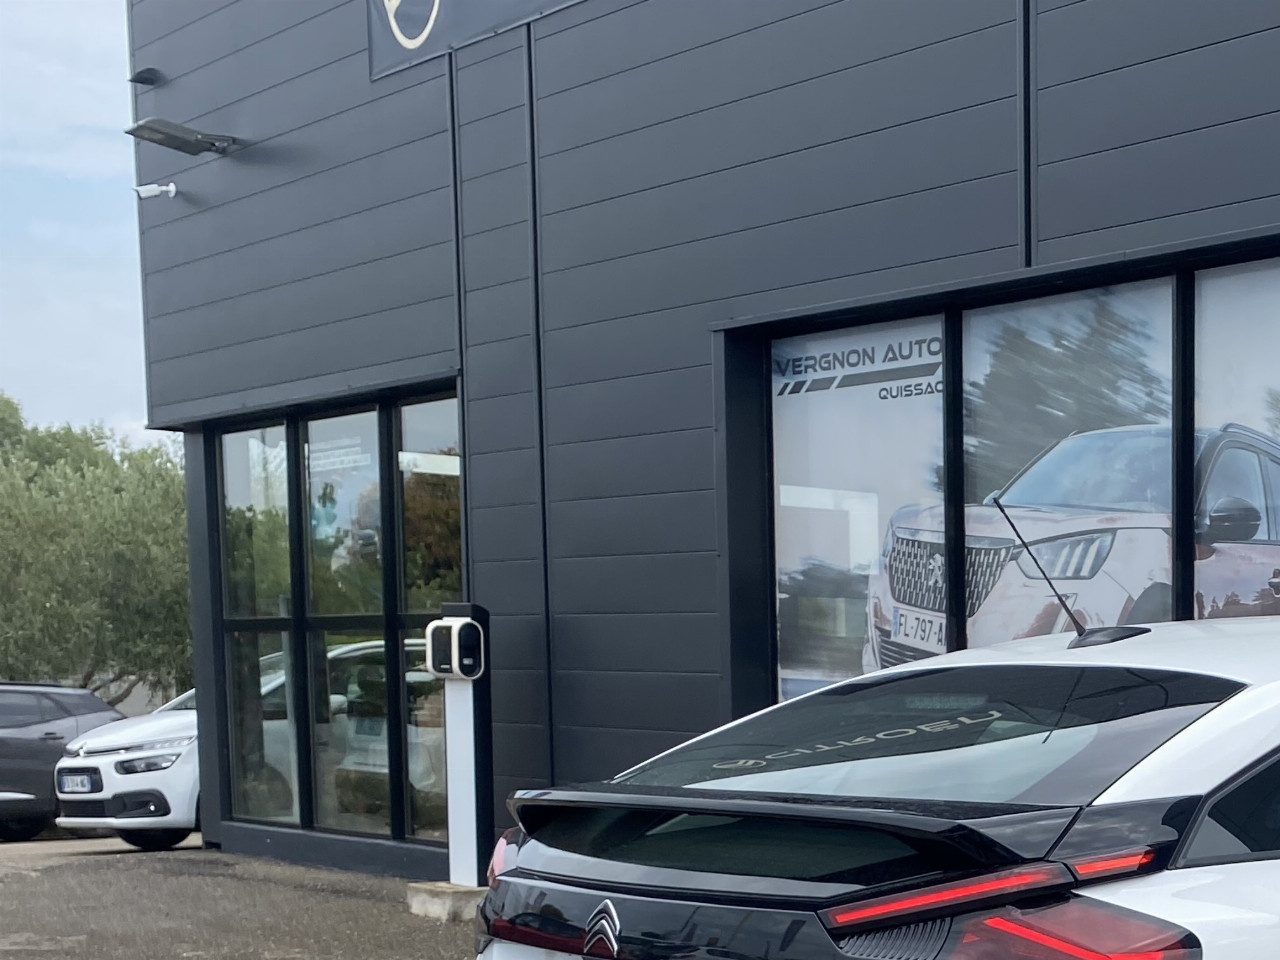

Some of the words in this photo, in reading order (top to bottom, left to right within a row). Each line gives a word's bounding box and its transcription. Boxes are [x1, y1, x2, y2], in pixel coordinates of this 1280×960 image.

[774, 346, 876, 377] VERGNON
[881, 336, 943, 364] AUTO
[878, 380, 944, 400] QUISSAC
[898, 613, 946, 646] FL-797-A
